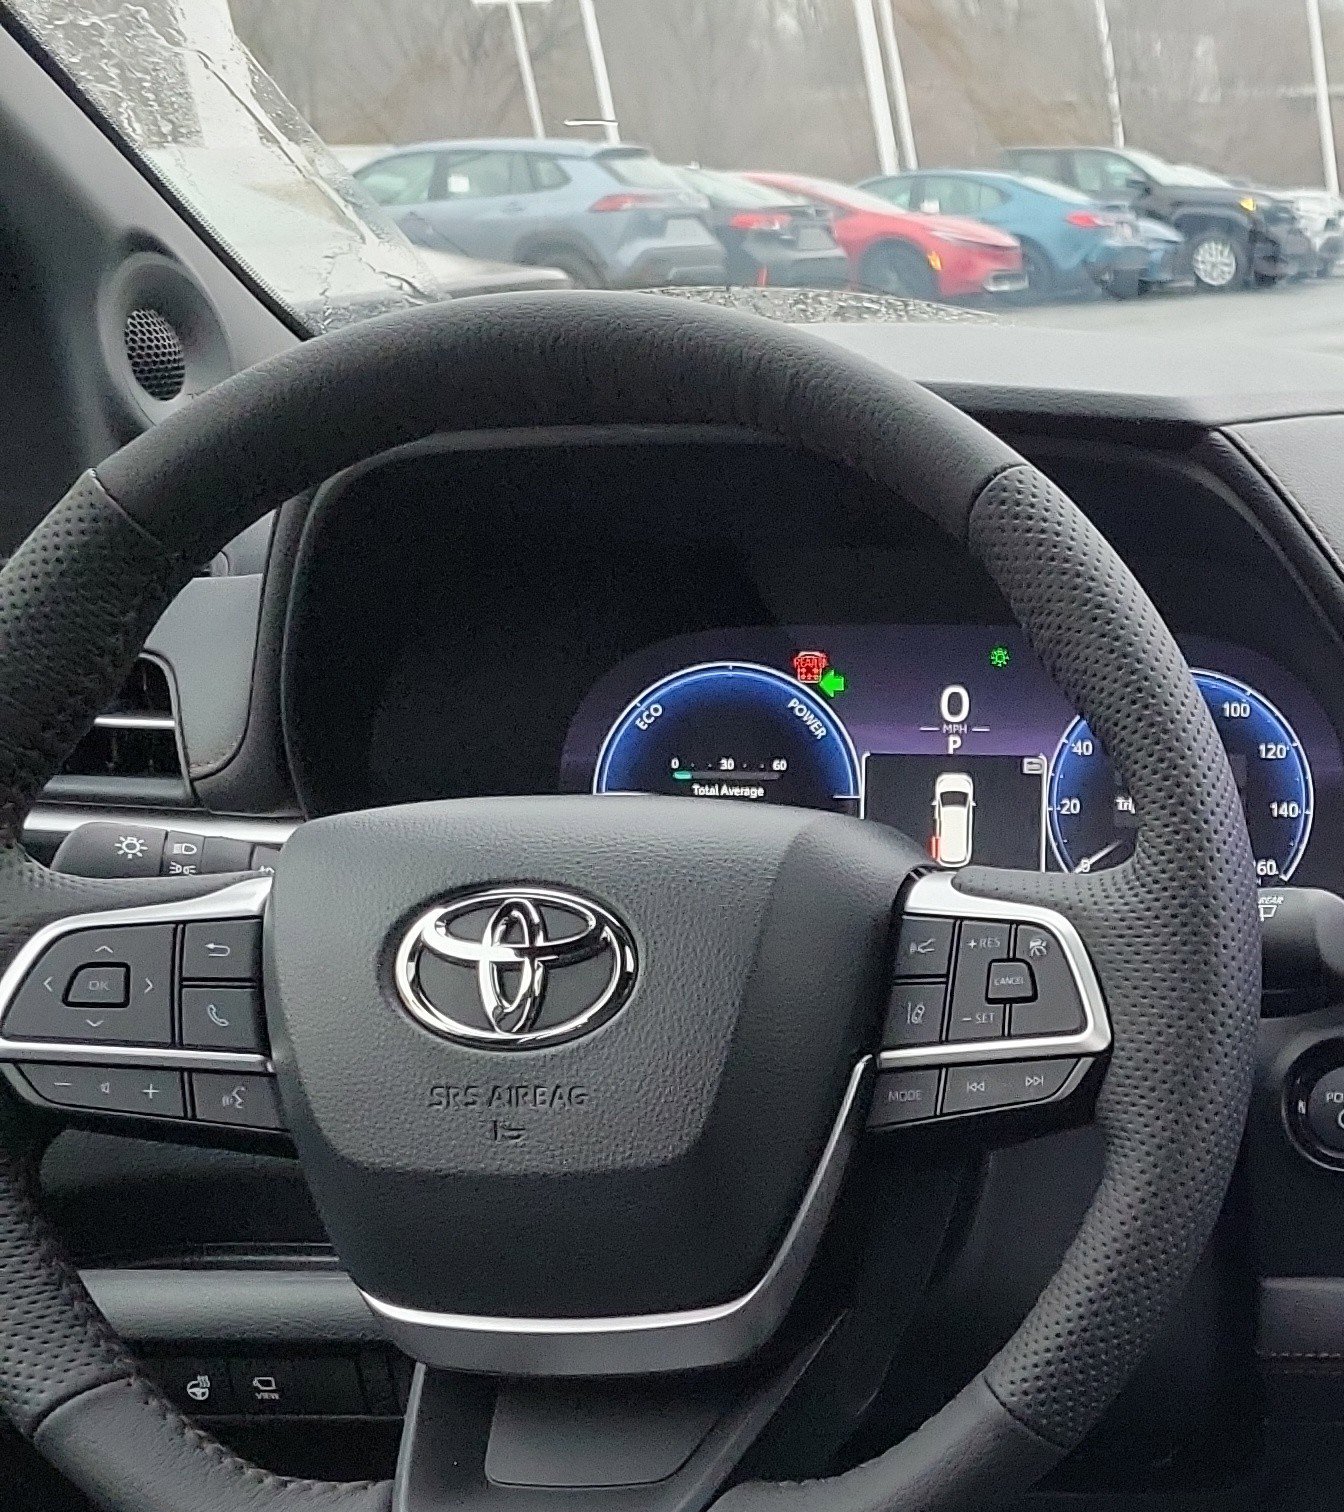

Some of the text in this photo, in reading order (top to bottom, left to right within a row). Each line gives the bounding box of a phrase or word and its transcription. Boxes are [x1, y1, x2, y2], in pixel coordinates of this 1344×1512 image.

[940, 684, 970, 723] 0
[1222, 702, 1250, 718] 100
[634, 702, 664, 731] ECO
[787, 697, 828, 740] POWER
[942, 724, 968, 735] MPH
[948, 735, 962, 755] P
[1073, 740, 1093, 756] 40
[1258, 743, 1286, 759] 120
[670, 757, 788, 771] 0 30 60
[691, 783, 765, 799] Total Average
[1059, 799, 1080, 815] 20
[1270, 801, 1299, 818] 140
[978, 938, 1001, 949] RES
[88, 980, 110, 992] OK
[975, 1012, 996, 1024] SET
[427, 1085, 590, 1109] SRS AIRBAG
[888, 1090, 922, 1102] MODE
